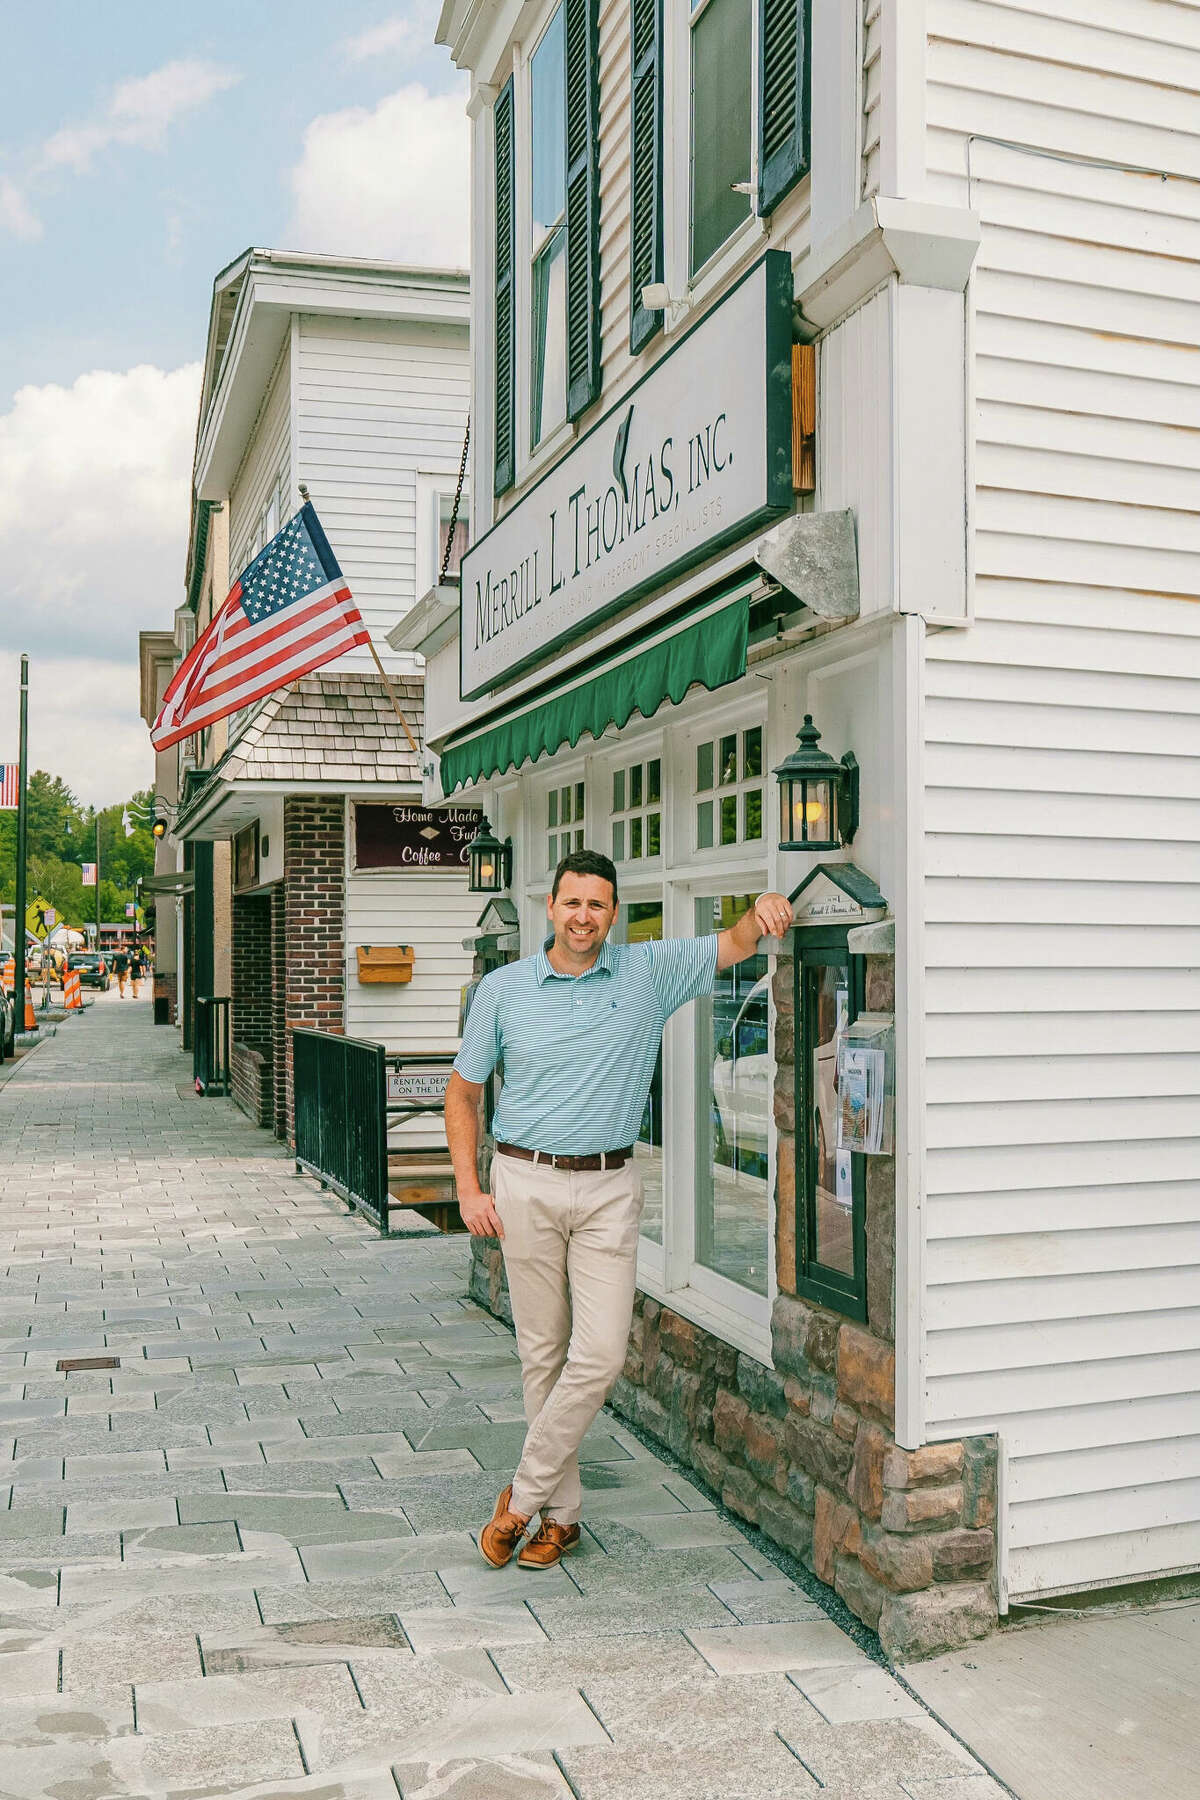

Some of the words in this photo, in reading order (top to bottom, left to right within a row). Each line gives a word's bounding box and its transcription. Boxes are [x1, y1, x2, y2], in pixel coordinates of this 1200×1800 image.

[474, 550, 541, 651] MERRILL
[549, 508, 566, 596] L.
[569, 438, 679, 579] THOMAS,
[688, 413, 733, 494] INC.
[393, 807, 433, 823] Home
[439, 808, 478, 823] Made
[450, 825, 481, 841] Fud
[401, 846, 441, 865] Coffee
[459, 844, 470, 863] C
[393, 1078, 426, 1086] RENTAL
[398, 1086, 412, 1094] ON
[416, 1086, 432, 1094] THE
